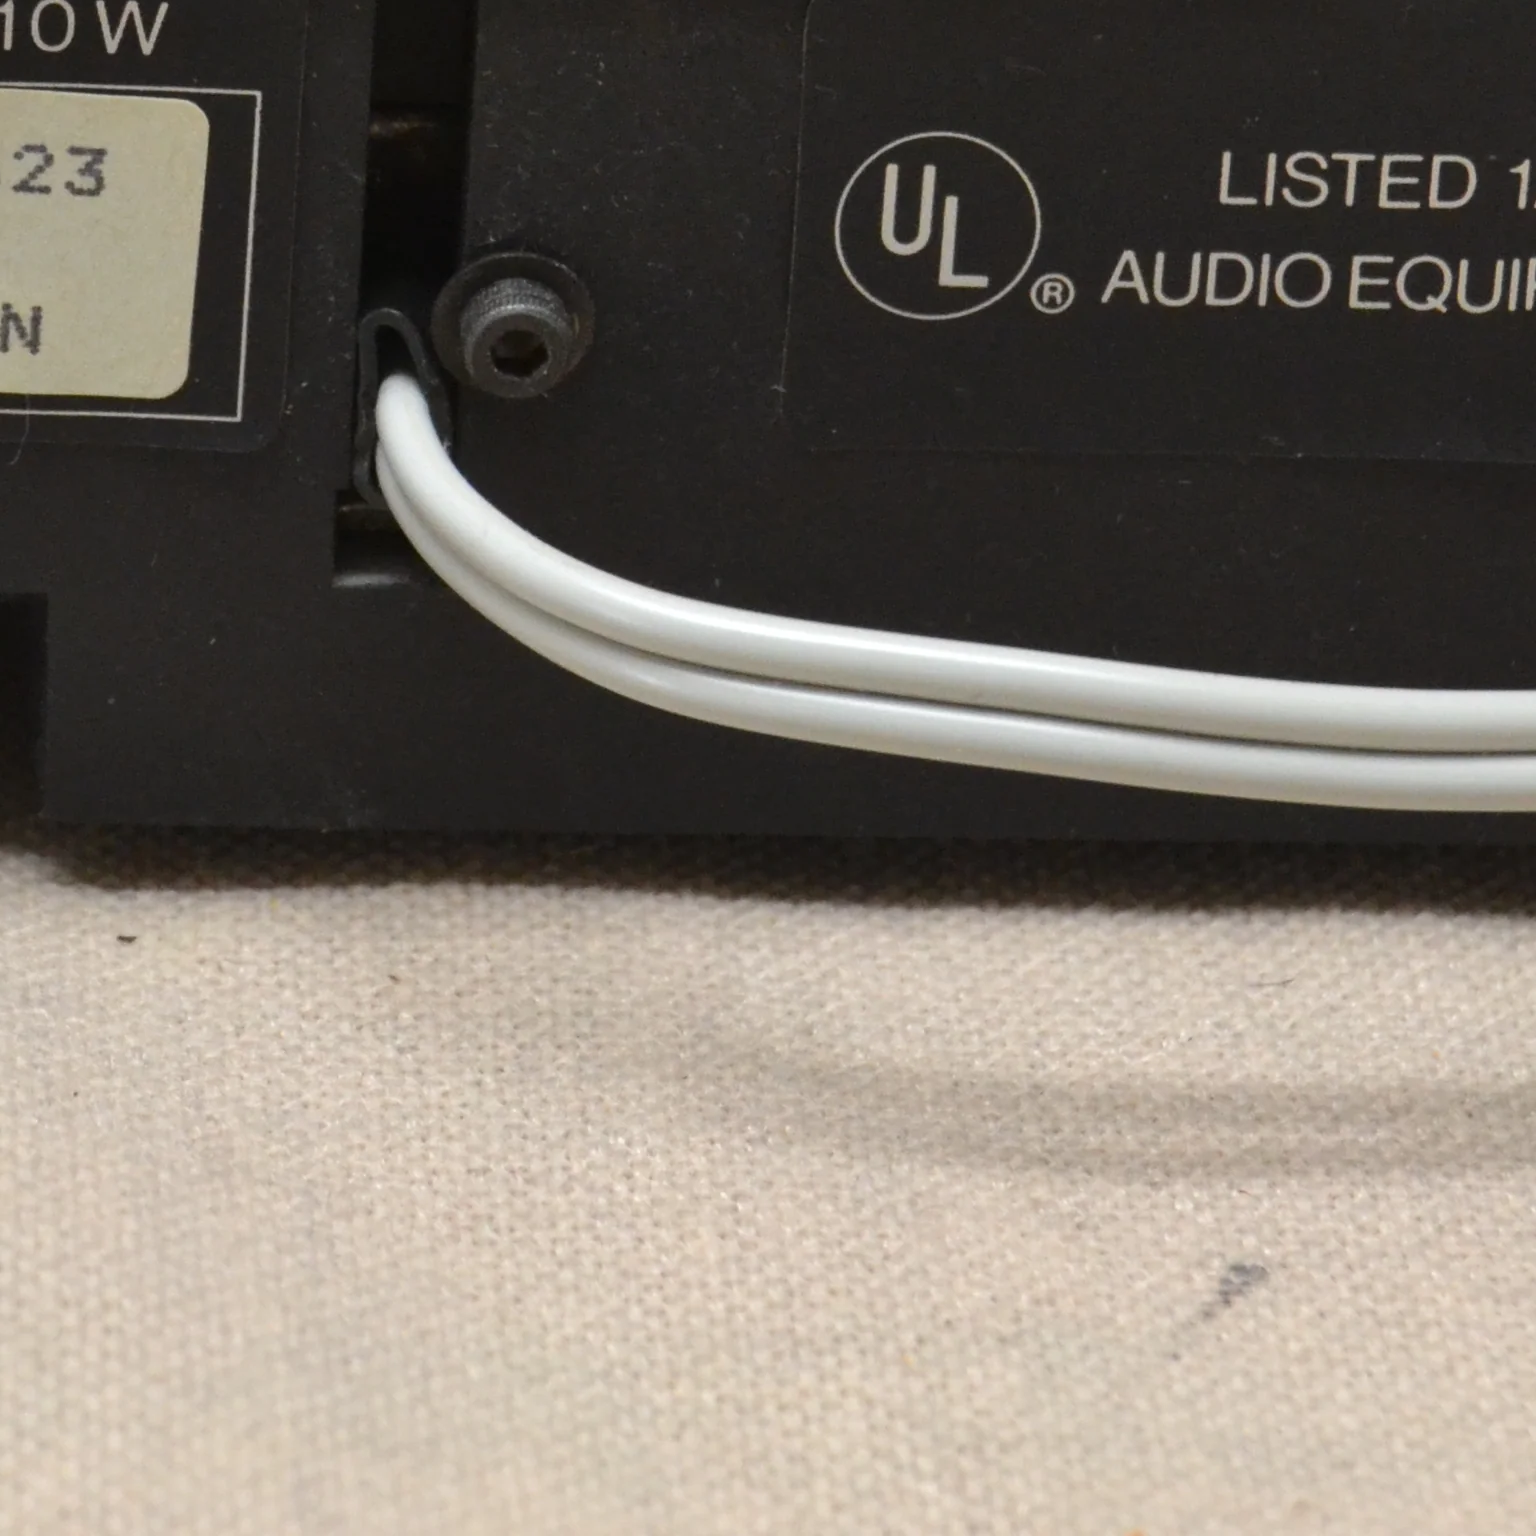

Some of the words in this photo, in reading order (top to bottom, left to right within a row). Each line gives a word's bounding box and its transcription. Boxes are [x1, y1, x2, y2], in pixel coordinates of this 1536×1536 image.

[1219, 150, 1478, 211] LISTED
[880, 163, 989, 288] UL
[1100, 249, 1333, 309] AUDIO
